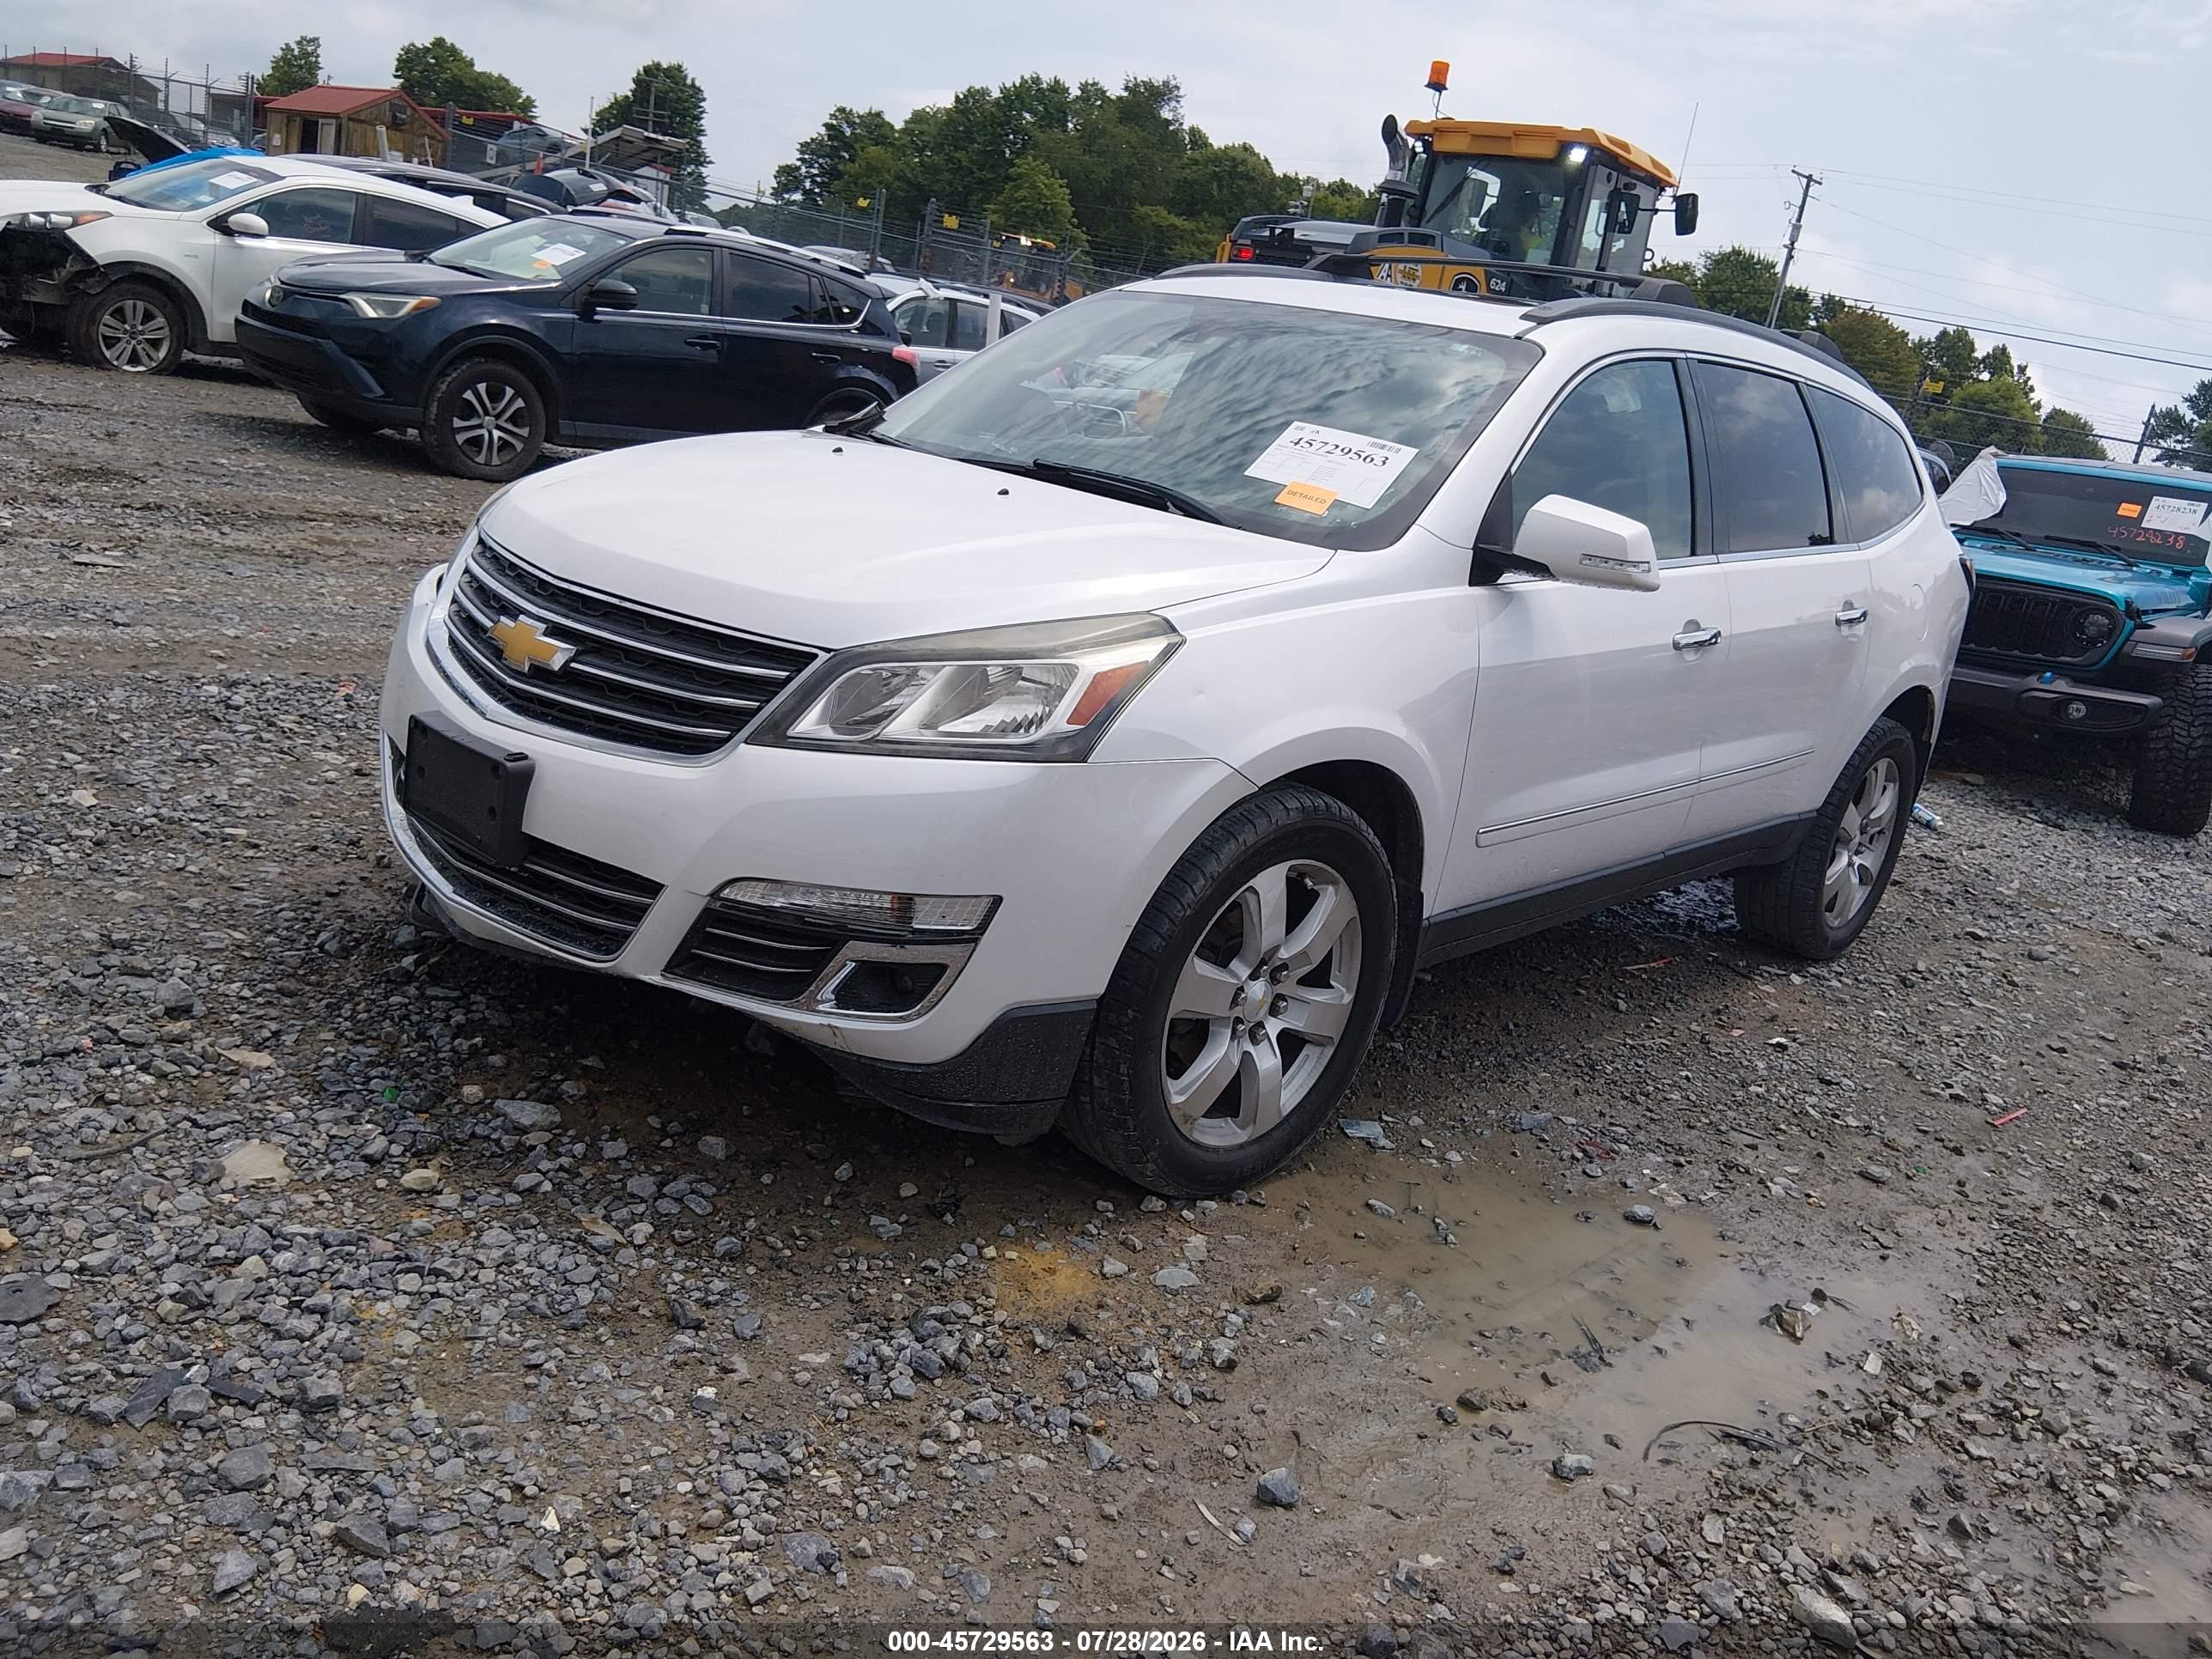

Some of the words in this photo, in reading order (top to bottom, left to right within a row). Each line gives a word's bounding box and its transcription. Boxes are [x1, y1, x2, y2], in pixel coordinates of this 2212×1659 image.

[1489, 277, 1507, 293] 624
[1289, 436, 1389, 467] 45729563
[1286, 489, 1328, 505] DETAILED
[2154, 503, 2198, 515] 45728238
